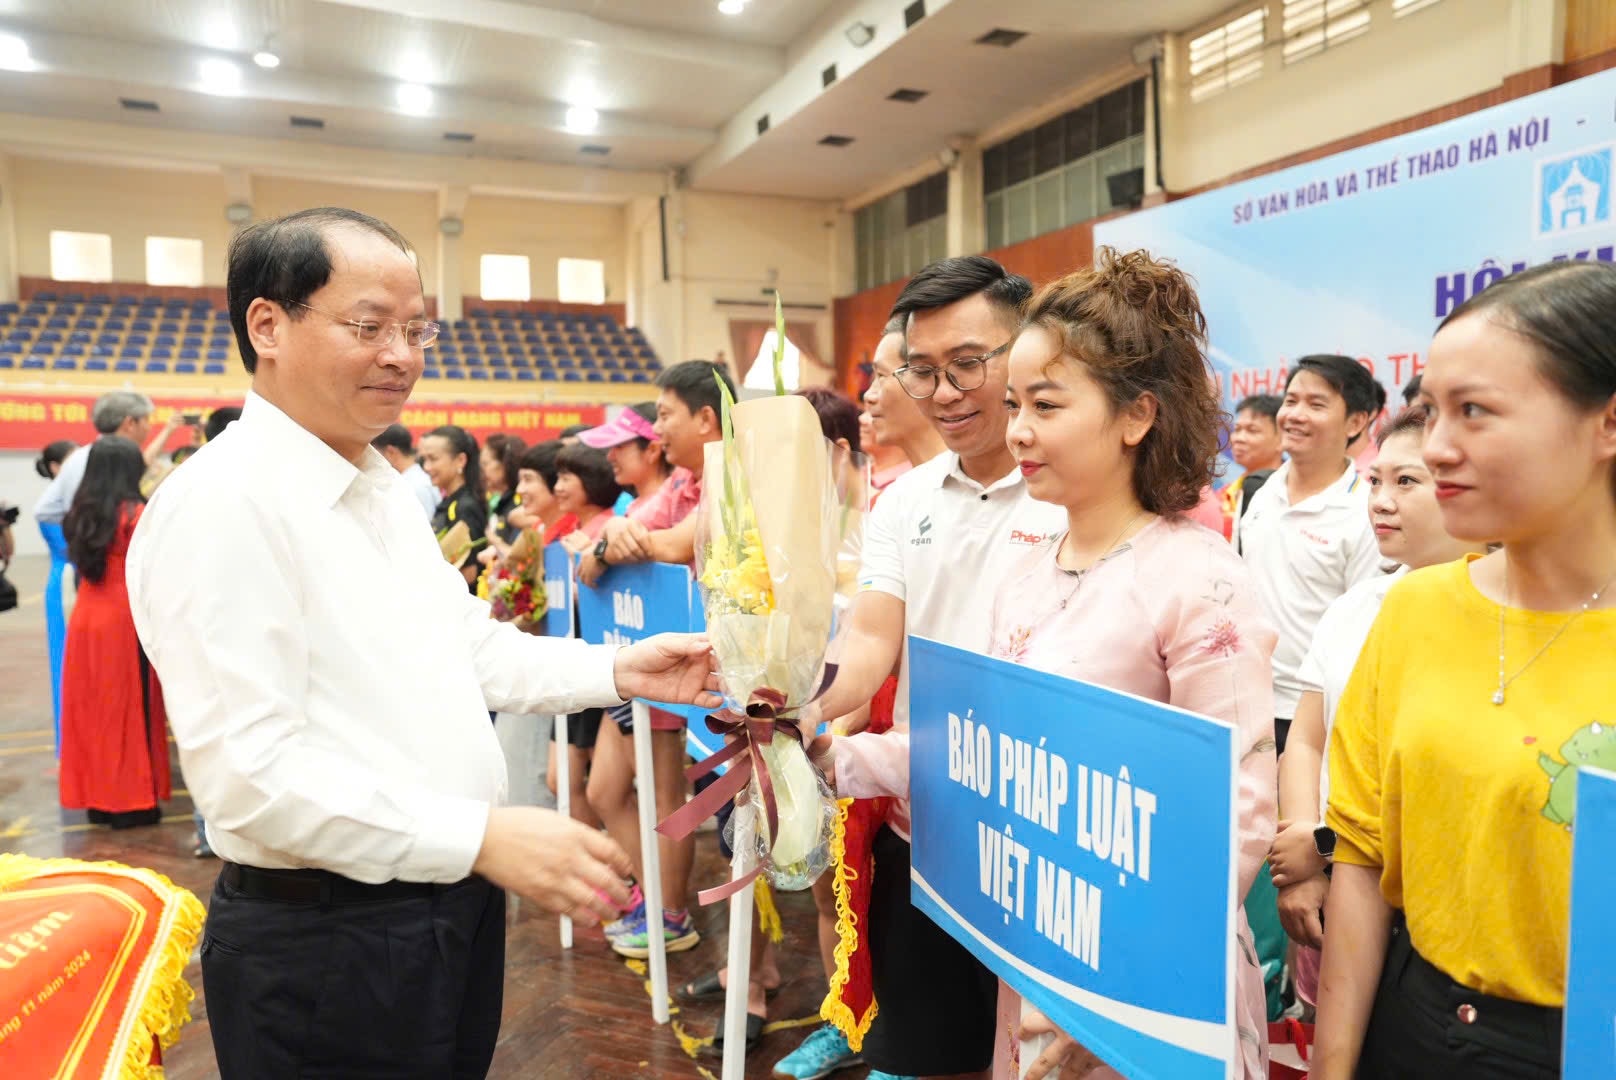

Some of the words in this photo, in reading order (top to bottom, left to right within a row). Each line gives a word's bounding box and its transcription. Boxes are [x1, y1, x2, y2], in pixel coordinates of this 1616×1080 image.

[1407, 144, 1460, 179] THAO
[613, 588, 644, 630] BÁO
[948, 708, 992, 799] BÁO
[999, 732, 1068, 834] PHÁP
[1076, 765, 1157, 887] LUẬT
[978, 820, 1030, 925] VIỆT
[1035, 855, 1101, 972] NAM
[22, 999, 36, 1016] 11
[63, 949, 91, 978] 2024
